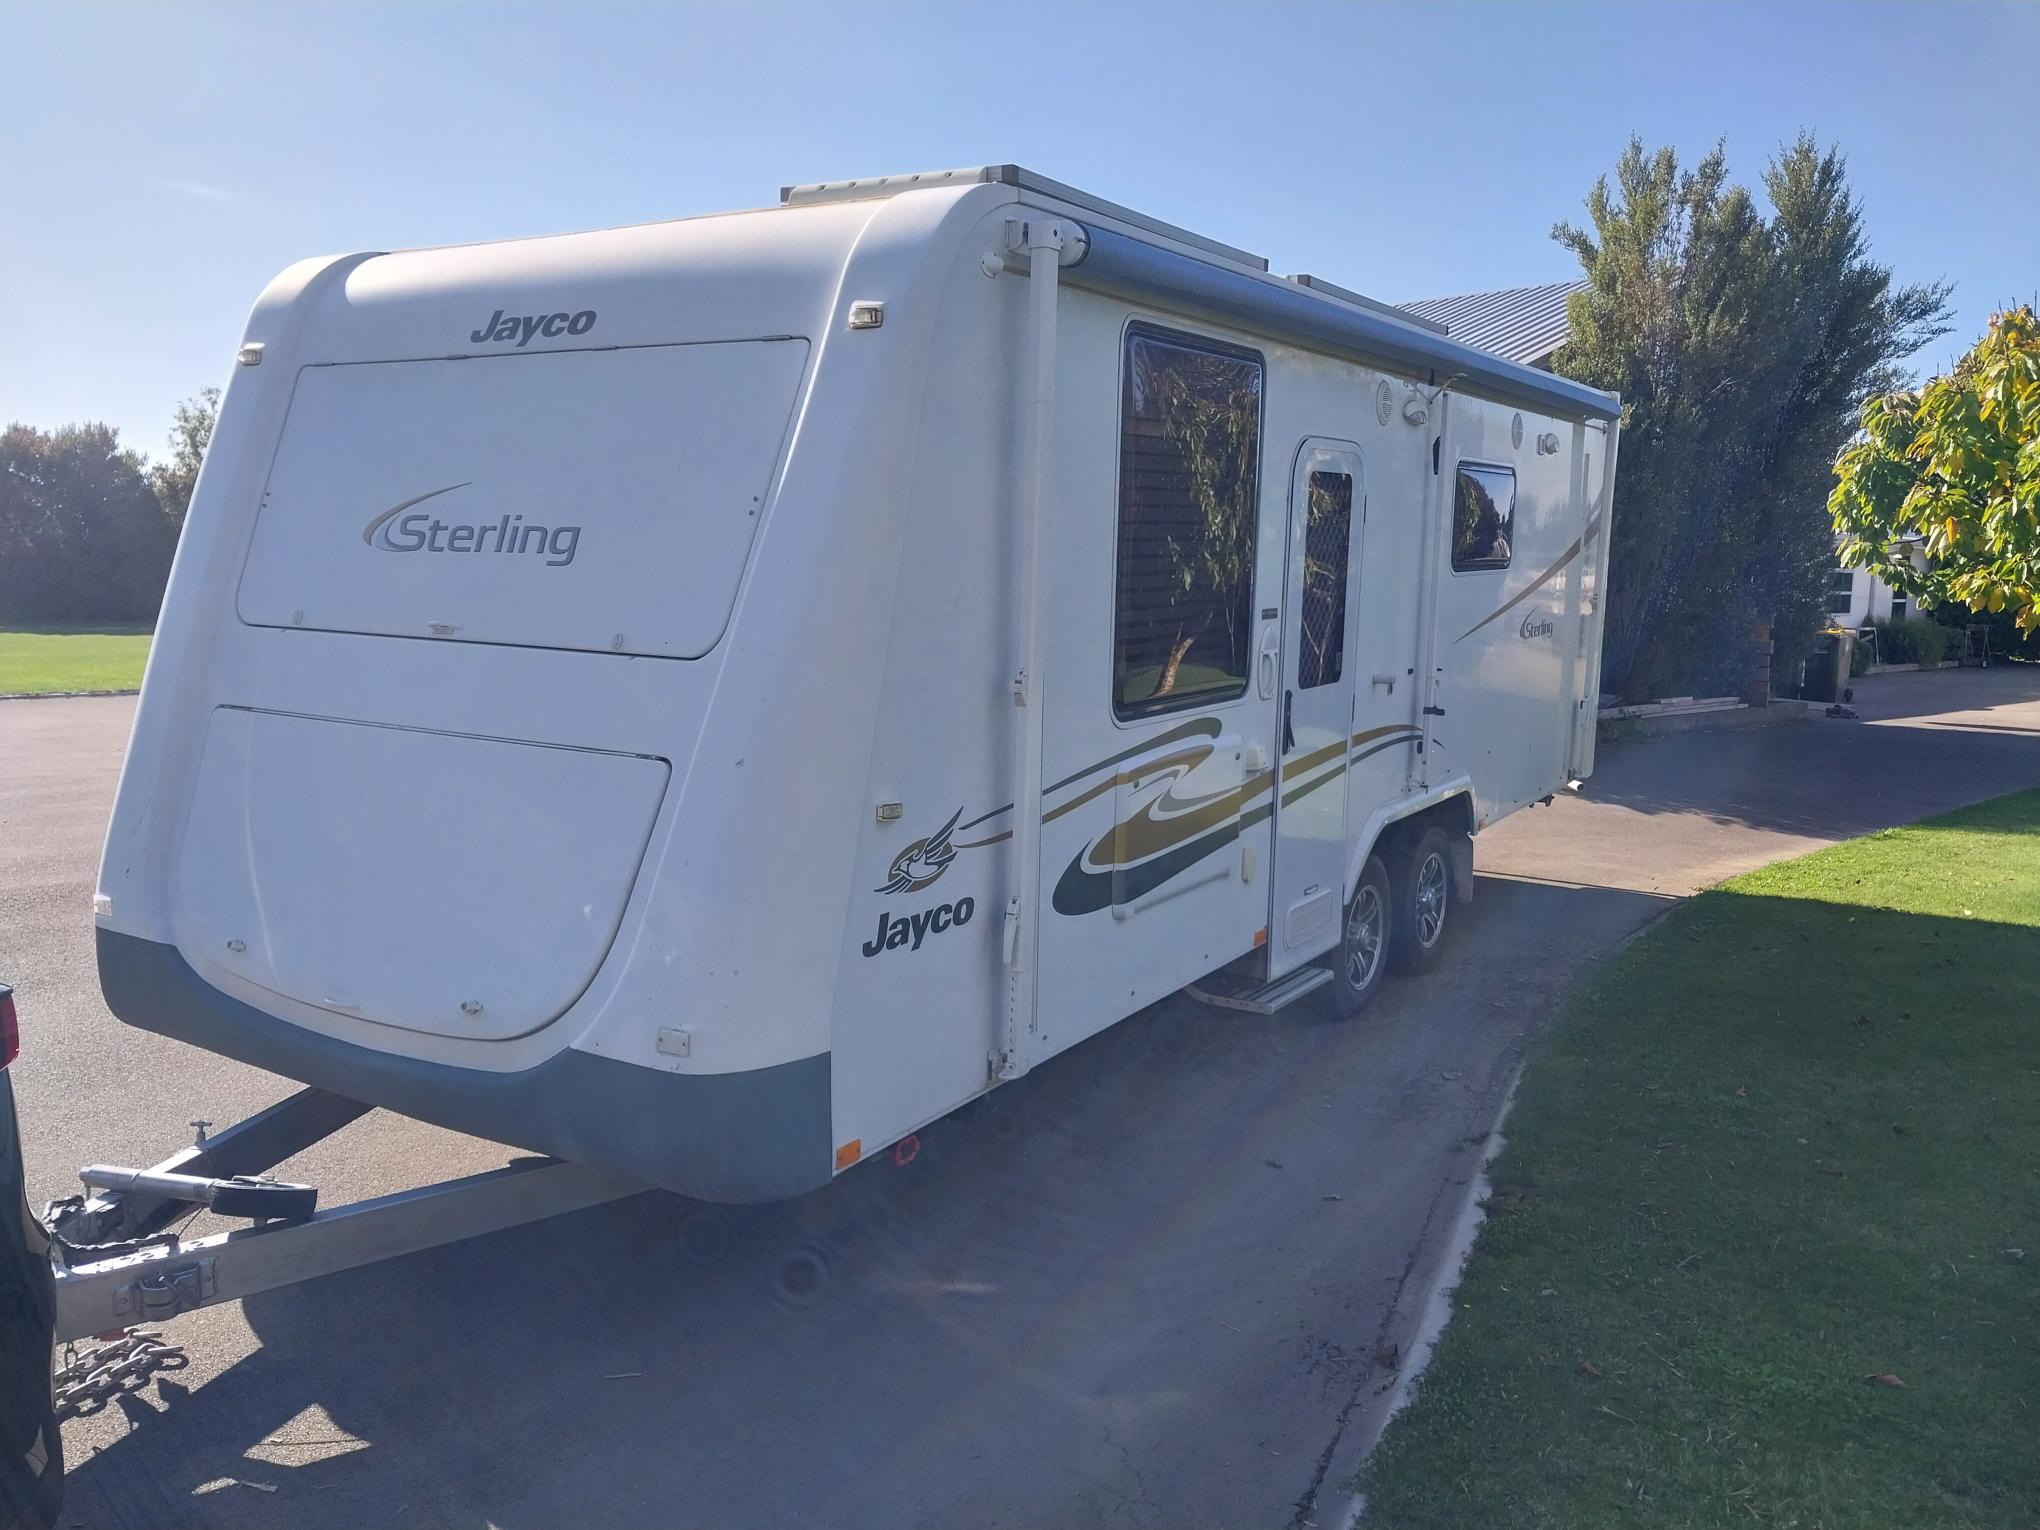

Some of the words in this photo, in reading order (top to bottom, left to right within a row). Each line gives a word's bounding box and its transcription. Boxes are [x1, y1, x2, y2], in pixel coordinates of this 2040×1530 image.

[470, 309, 597, 347] Jayco
[385, 514, 582, 567] Sterling
[1524, 618, 1553, 639] Sterling
[862, 896, 975, 958] Jayco
